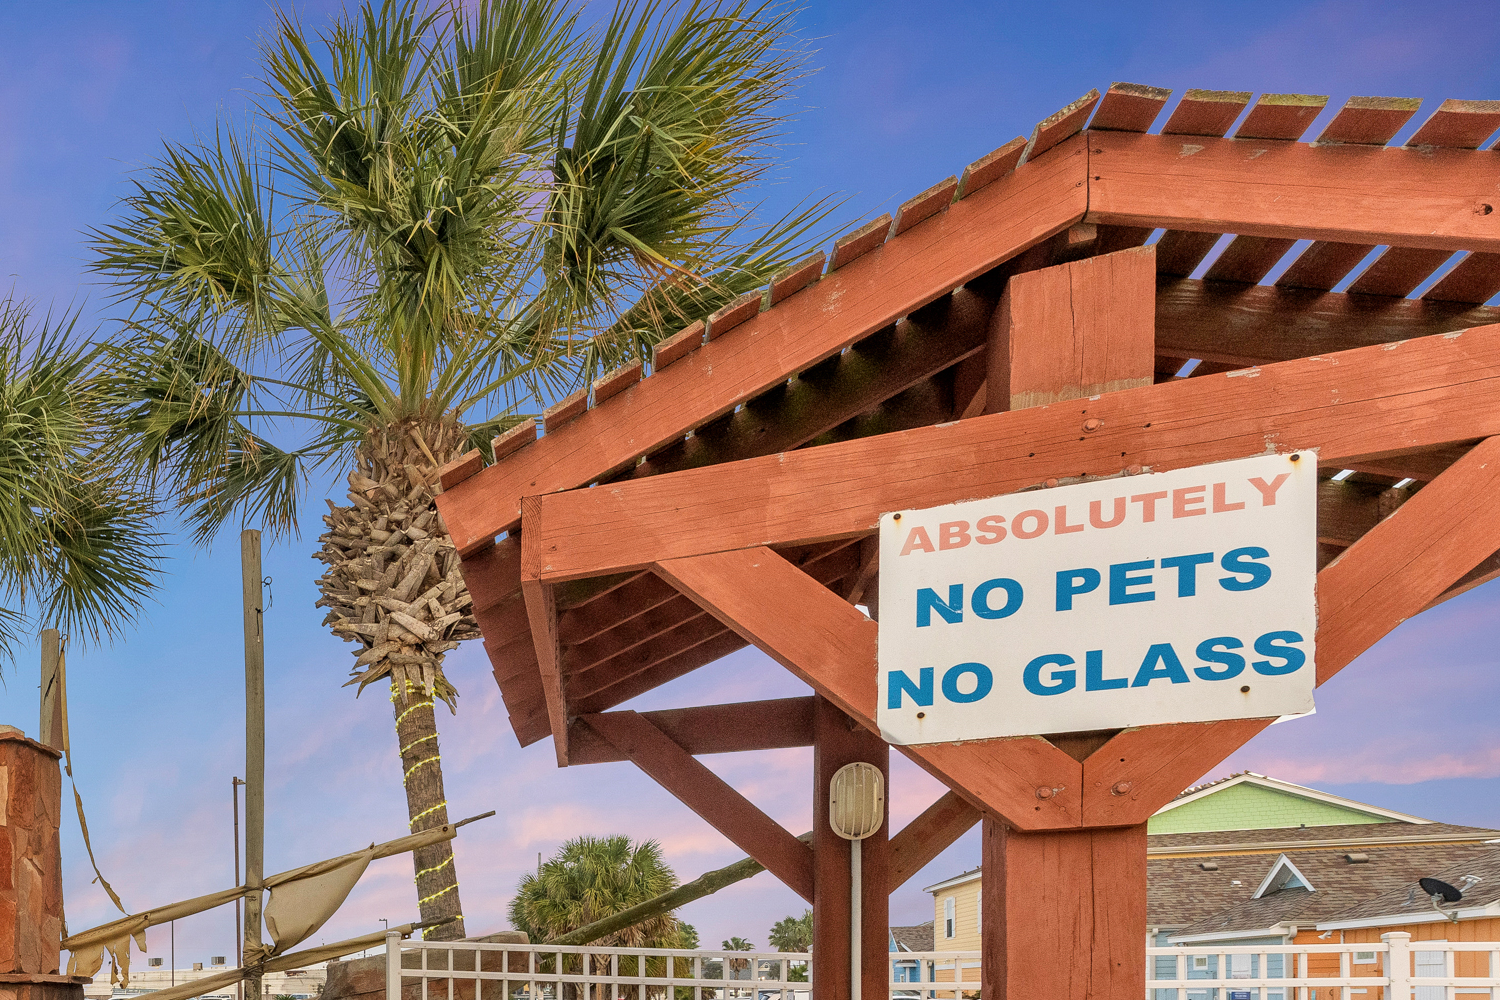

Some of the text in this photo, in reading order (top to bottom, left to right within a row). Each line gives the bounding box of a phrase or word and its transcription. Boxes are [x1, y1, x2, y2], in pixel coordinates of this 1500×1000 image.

[899, 472, 1292, 556] ABSOLUTELY
[916, 546, 1272, 628] NO PETS
[887, 630, 1306, 710] NO GLASS
